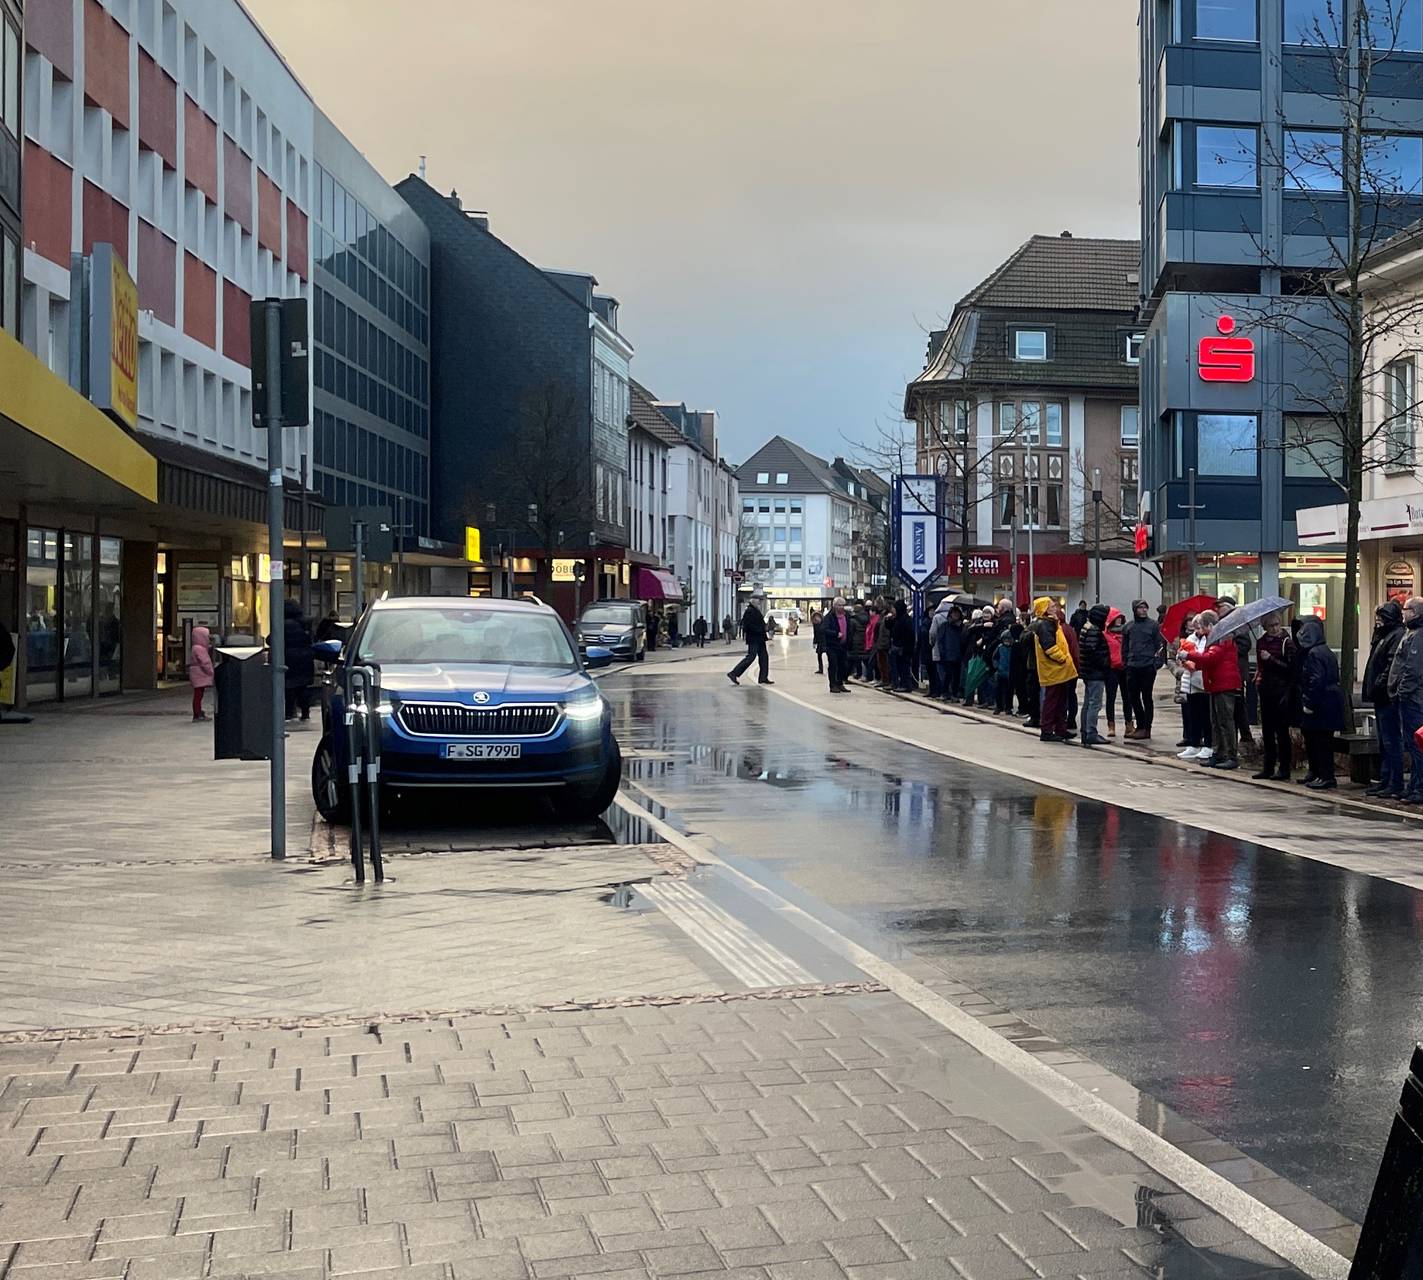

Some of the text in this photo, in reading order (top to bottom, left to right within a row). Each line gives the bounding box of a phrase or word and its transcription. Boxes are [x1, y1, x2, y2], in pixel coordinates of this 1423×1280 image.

[448, 745, 519, 757] F SG 7990
